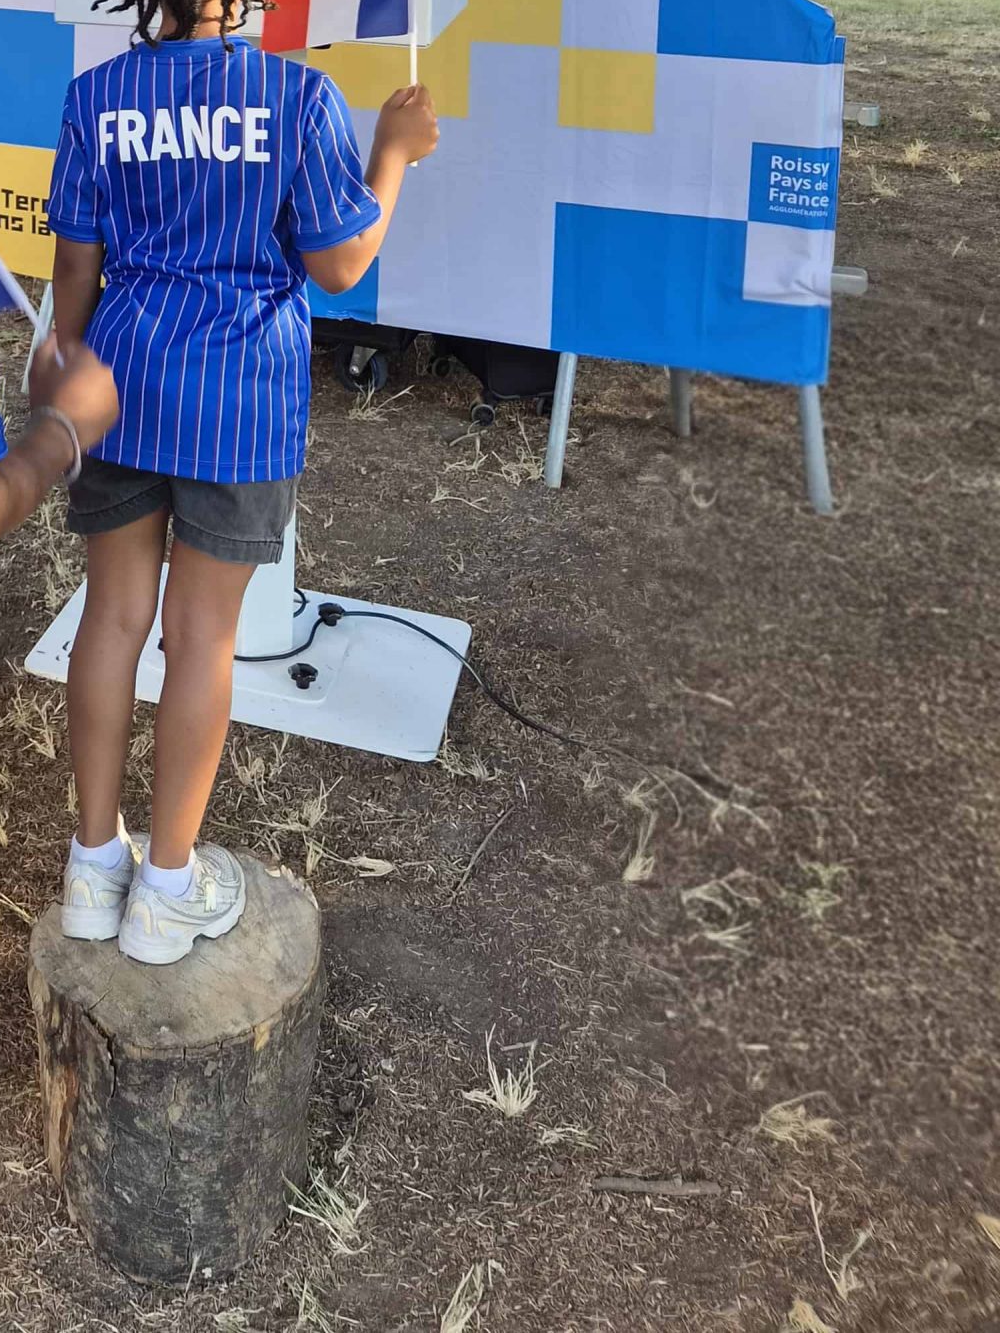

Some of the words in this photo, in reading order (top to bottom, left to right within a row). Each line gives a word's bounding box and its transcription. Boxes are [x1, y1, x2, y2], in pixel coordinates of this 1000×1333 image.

[99, 106, 271, 165] FRANCE
[771, 155, 830, 177] Roissy
[770, 172, 812, 191] Pays
[814, 180, 828, 191] de
[769, 188, 830, 207] France
[32, 215, 51, 236] la
